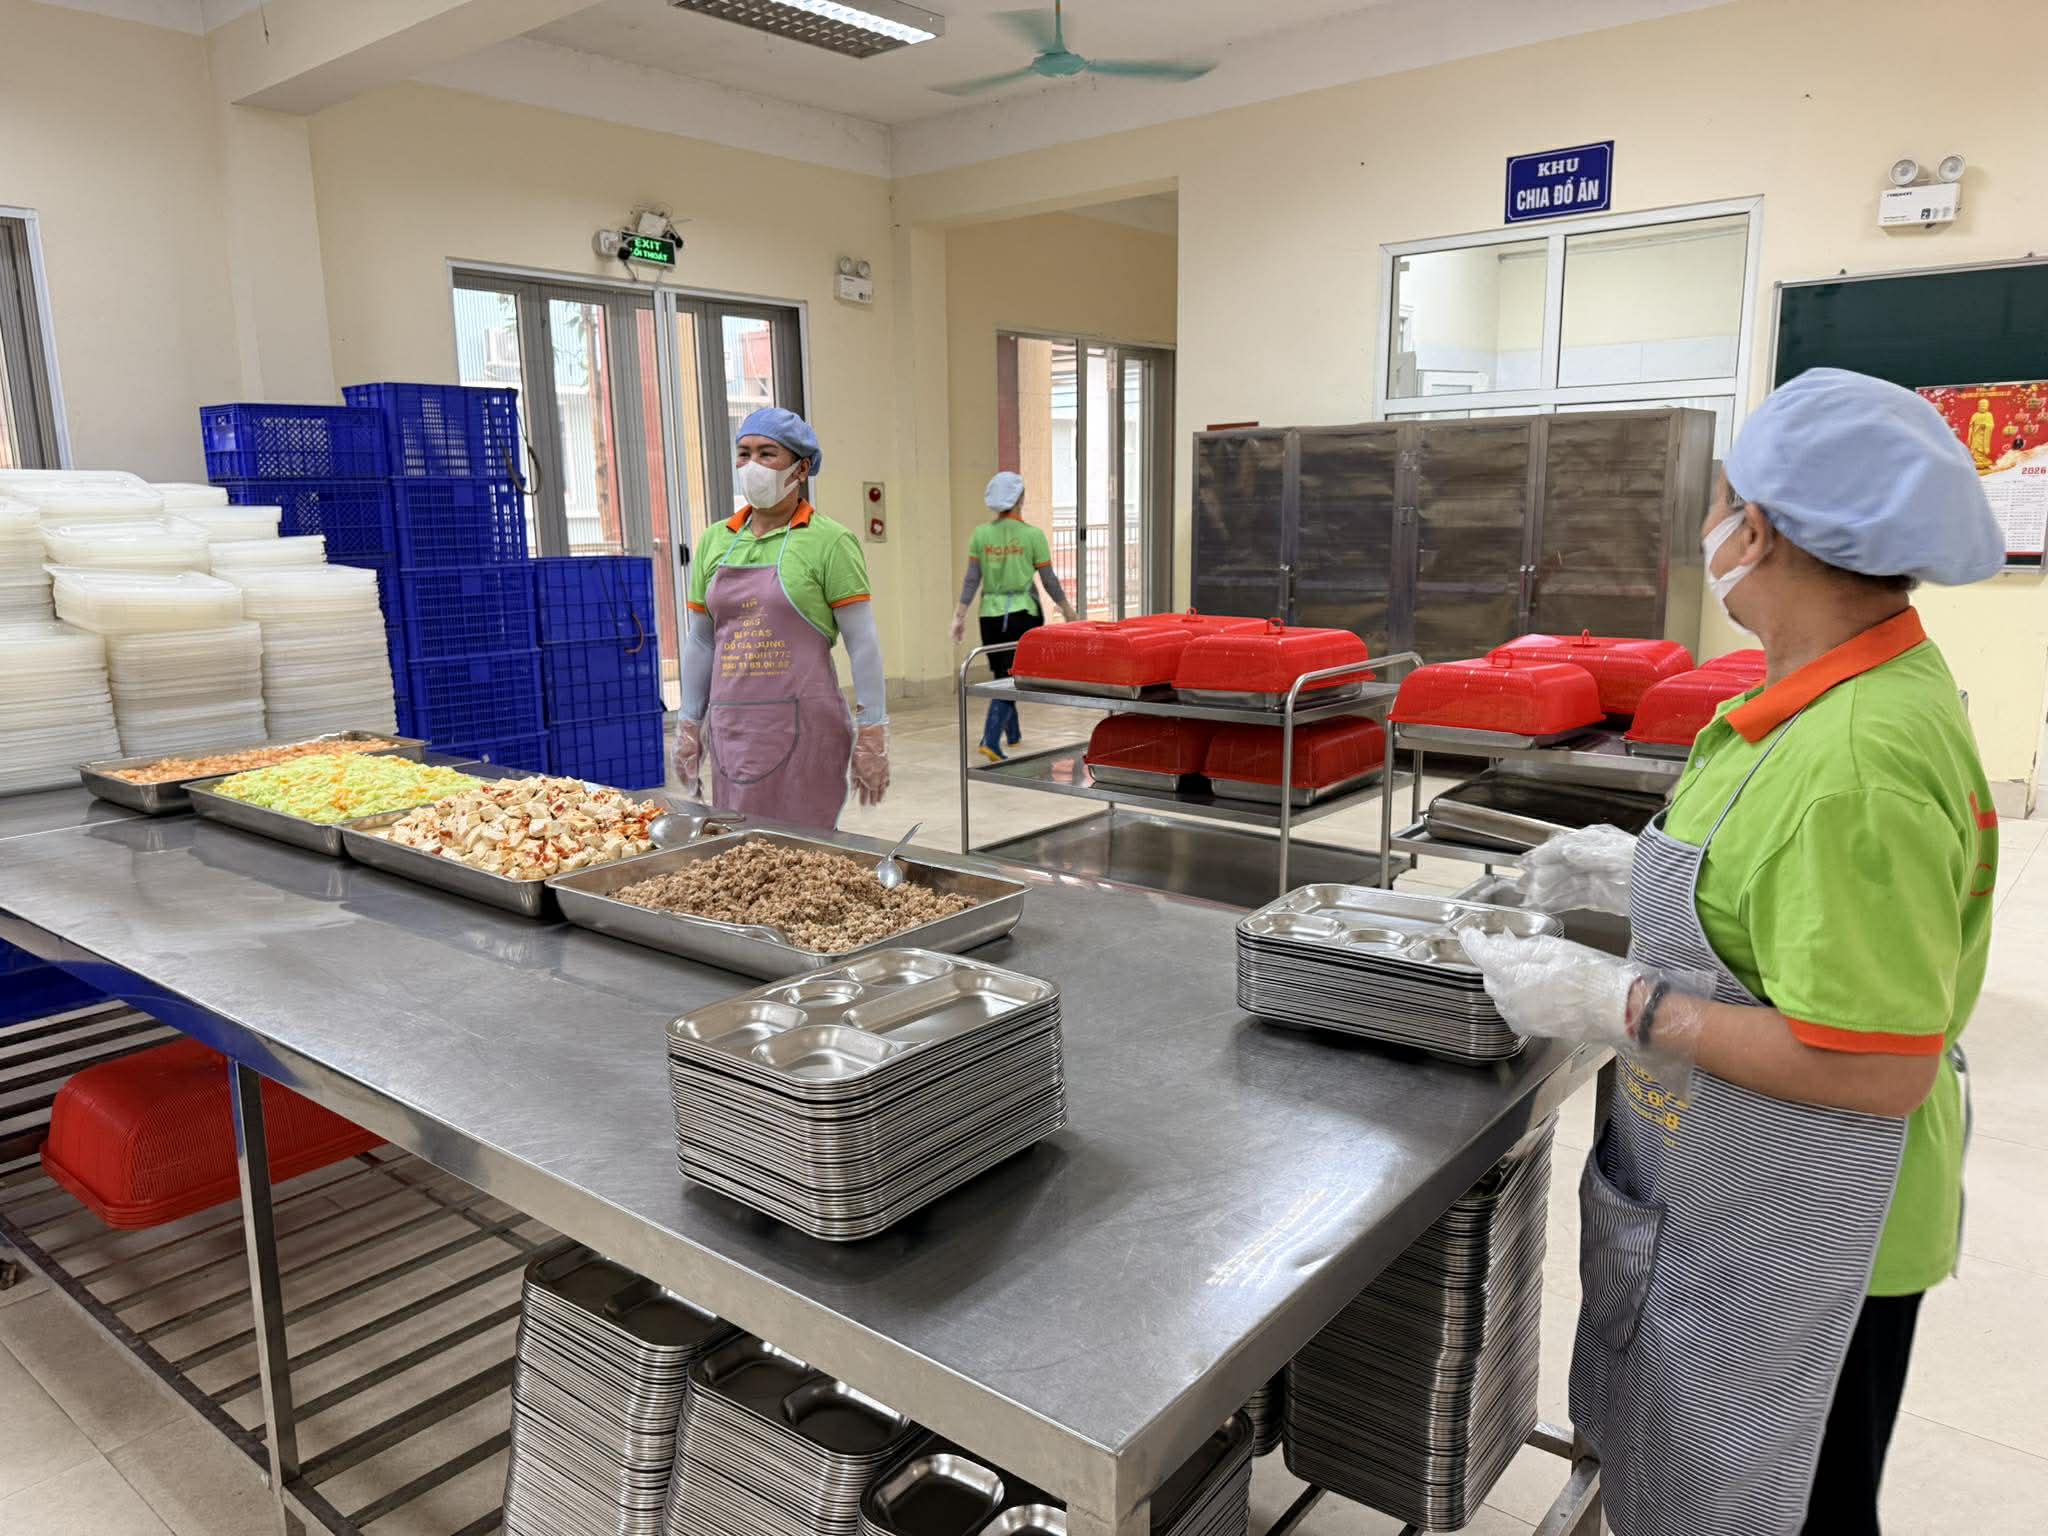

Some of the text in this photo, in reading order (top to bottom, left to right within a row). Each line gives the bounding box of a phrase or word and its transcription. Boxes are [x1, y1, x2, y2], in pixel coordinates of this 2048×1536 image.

[1537, 157, 1580, 177] KHU
[1516, 186, 1550, 211] CHIA
[1577, 177, 1599, 203] ĂN
[634, 238, 662, 251] EXIT
[2021, 466, 2047, 475] 2026
